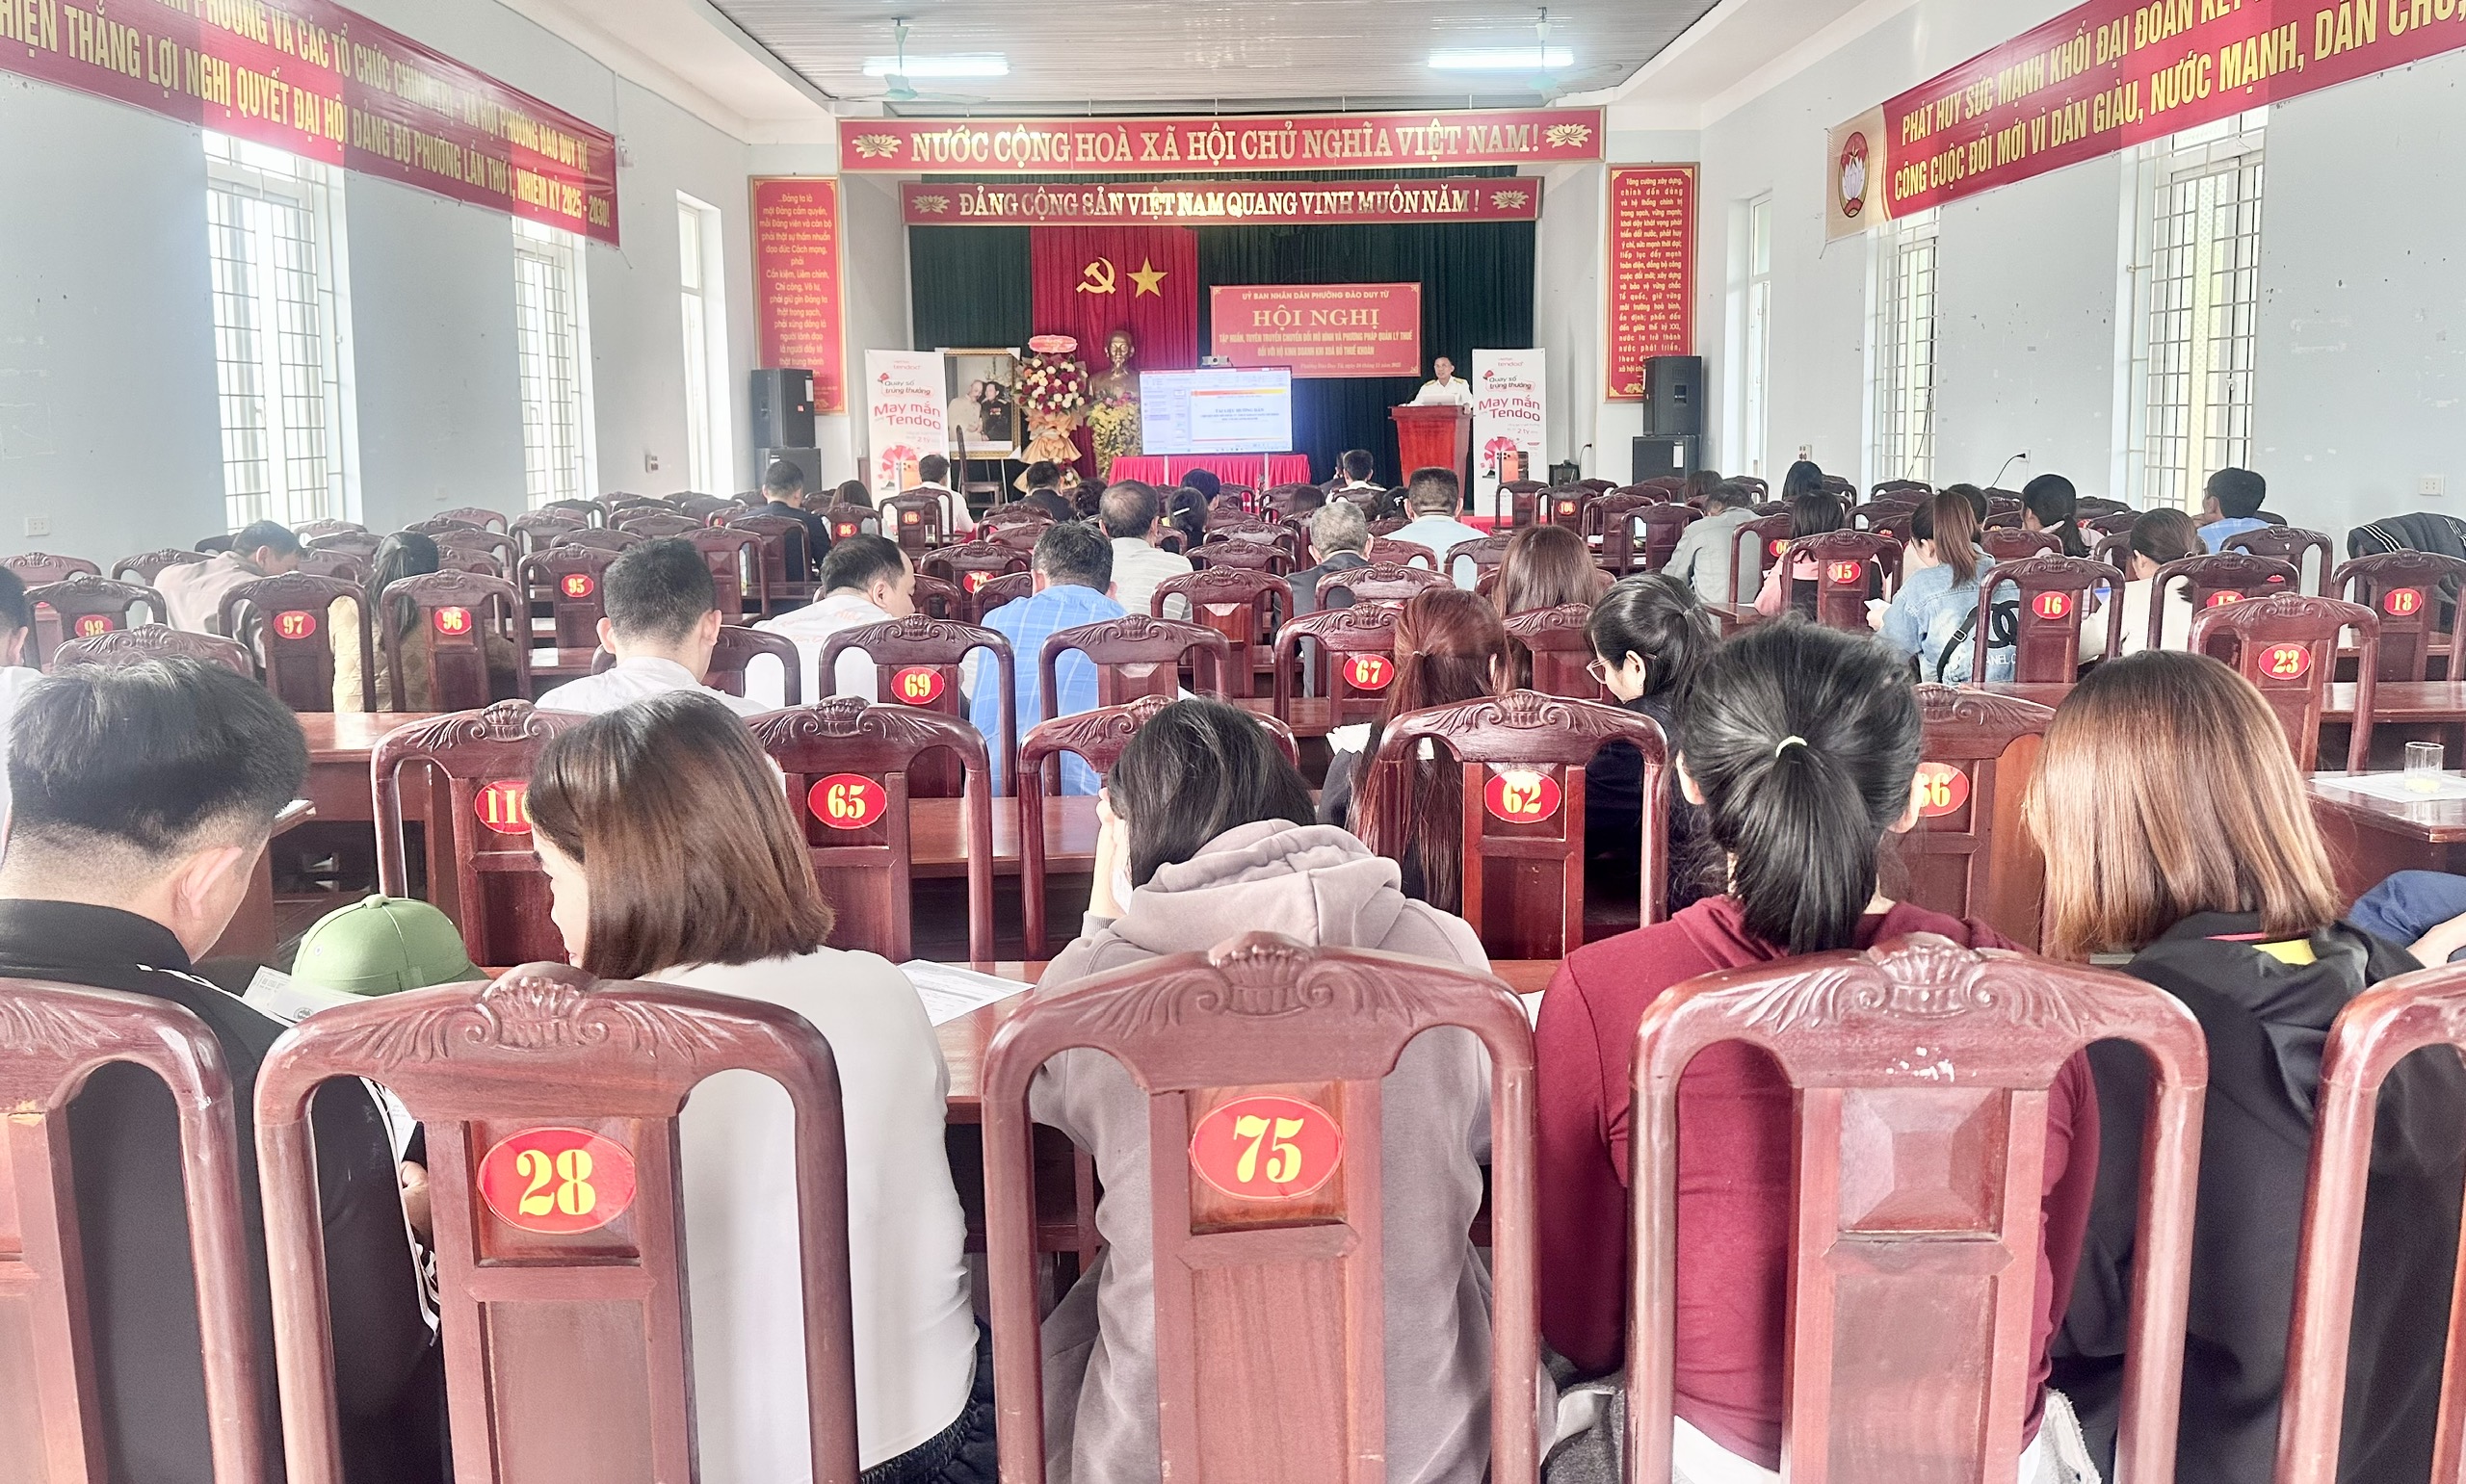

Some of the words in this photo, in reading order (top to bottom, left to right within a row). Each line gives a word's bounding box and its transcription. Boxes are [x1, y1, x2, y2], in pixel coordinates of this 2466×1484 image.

[271, 3, 295, 56] VÀ
[298, 13, 329, 68] CÁC
[331, 22, 351, 77] TỔ
[354, 43, 391, 92] CHỨC
[480, 93, 498, 142] HỘI
[499, 106, 539, 152] PHƯỜNG
[539, 120, 559, 160] ĐÀO
[559, 132, 576, 168] DUY
[1902, 96, 1934, 146] PHÁT
[1936, 91, 1962, 134] HUY
[1964, 74, 1994, 120] SỨC
[1998, 56, 2046, 108] MẠNH
[2050, 20, 2091, 86] KHỐI
[2096, 14, 2128, 69] ĐẠI
[1895, 158, 1927, 201] CÔNG
[1929, 143, 1965, 190] CUỘC
[1968, 123, 1992, 176] ĐỔI
[1996, 117, 2027, 167] MỚI
[2031, 107, 2047, 155] VÌ
[2051, 97, 2088, 149] DÂN
[2092, 78, 2145, 134] GIÀU,
[2150, 50, 2213, 117] NƯỚC
[2218, 21, 2305, 94] MẠNH,
[2314, 0, 2377, 62] DÂN
[146, 36, 179, 98] LỢI
[185, 47, 231, 117] NGHỊ
[236, 66, 290, 125] QUYẾT
[293, 87, 321, 143] ĐẠI
[324, 93, 349, 150] HỘI
[353, 98, 390, 158] ĐẢNG
[393, 117, 410, 171] BỘ
[414, 131, 462, 180] PHƯỜNG
[464, 139, 485, 188] LẦN
[486, 155, 507, 195] THỨ
[516, 167, 548, 212] NHIỆM
[548, 174, 561, 212] KỲ
[561, 184, 583, 219] 2025
[588, 195, 610, 228] 2030!
[910, 124, 989, 163] NƯỚC
[993, 123, 1071, 169] CỘNG
[1074, 124, 1134, 162] HOÀ
[1140, 125, 1181, 162] XÃ
[1187, 121, 1237, 167] HỘI
[1240, 119, 1298, 161] CHỦ
[1302, 120, 1393, 159] NGHĨA
[1396, 117, 1462, 162] VIỆT
[958, 185, 1018, 217] ĐẢNG
[1021, 186, 1078, 221] CỘNG
[1082, 185, 1123, 217] SẢN
[1128, 186, 1175, 221] VIỆT
[1176, 192, 1225, 216] NAM
[1226, 191, 1298, 219] QUANG
[1300, 190, 1355, 216] VINH
[1356, 183, 1421, 215] MUÔN
[1421, 183, 1470, 214] NĂM
[1253, 292, 1270, 300] BAN
[1271, 291, 1293, 299] NHÂN
[1294, 291, 1310, 299] DÂN
[1311, 290, 1343, 299] PHƯỜNG
[1345, 290, 1362, 299] ĐÀO
[1379, 290, 1390, 299] TỪ
[1252, 304, 1302, 331] HỘI
[1309, 308, 1379, 330] NGHỊ
[875, 403, 906, 417] May
[910, 401, 941, 418] mắn
[1479, 397, 1508, 411] May
[1512, 394, 1540, 410] mắn
[1489, 407, 1540, 422] Tendoo
[886, 415, 941, 430] Tendoo
[1837, 563, 1852, 579] 15
[567, 578, 585, 594] 95
[2043, 596, 2062, 614] 16
[2393, 592, 2413, 612] 18
[84, 619, 104, 637] 98
[282, 615, 304, 635] 97
[442, 611, 462, 631] 96
[1355, 659, 1383, 685] 67
[2272, 649, 2300, 674] 23
[904, 673, 931, 697] 69
[826, 784, 866, 818] 65
[1502, 777, 1542, 814] 62
[1233, 1115, 1305, 1184] 75
[515, 1149, 596, 1215] 28
